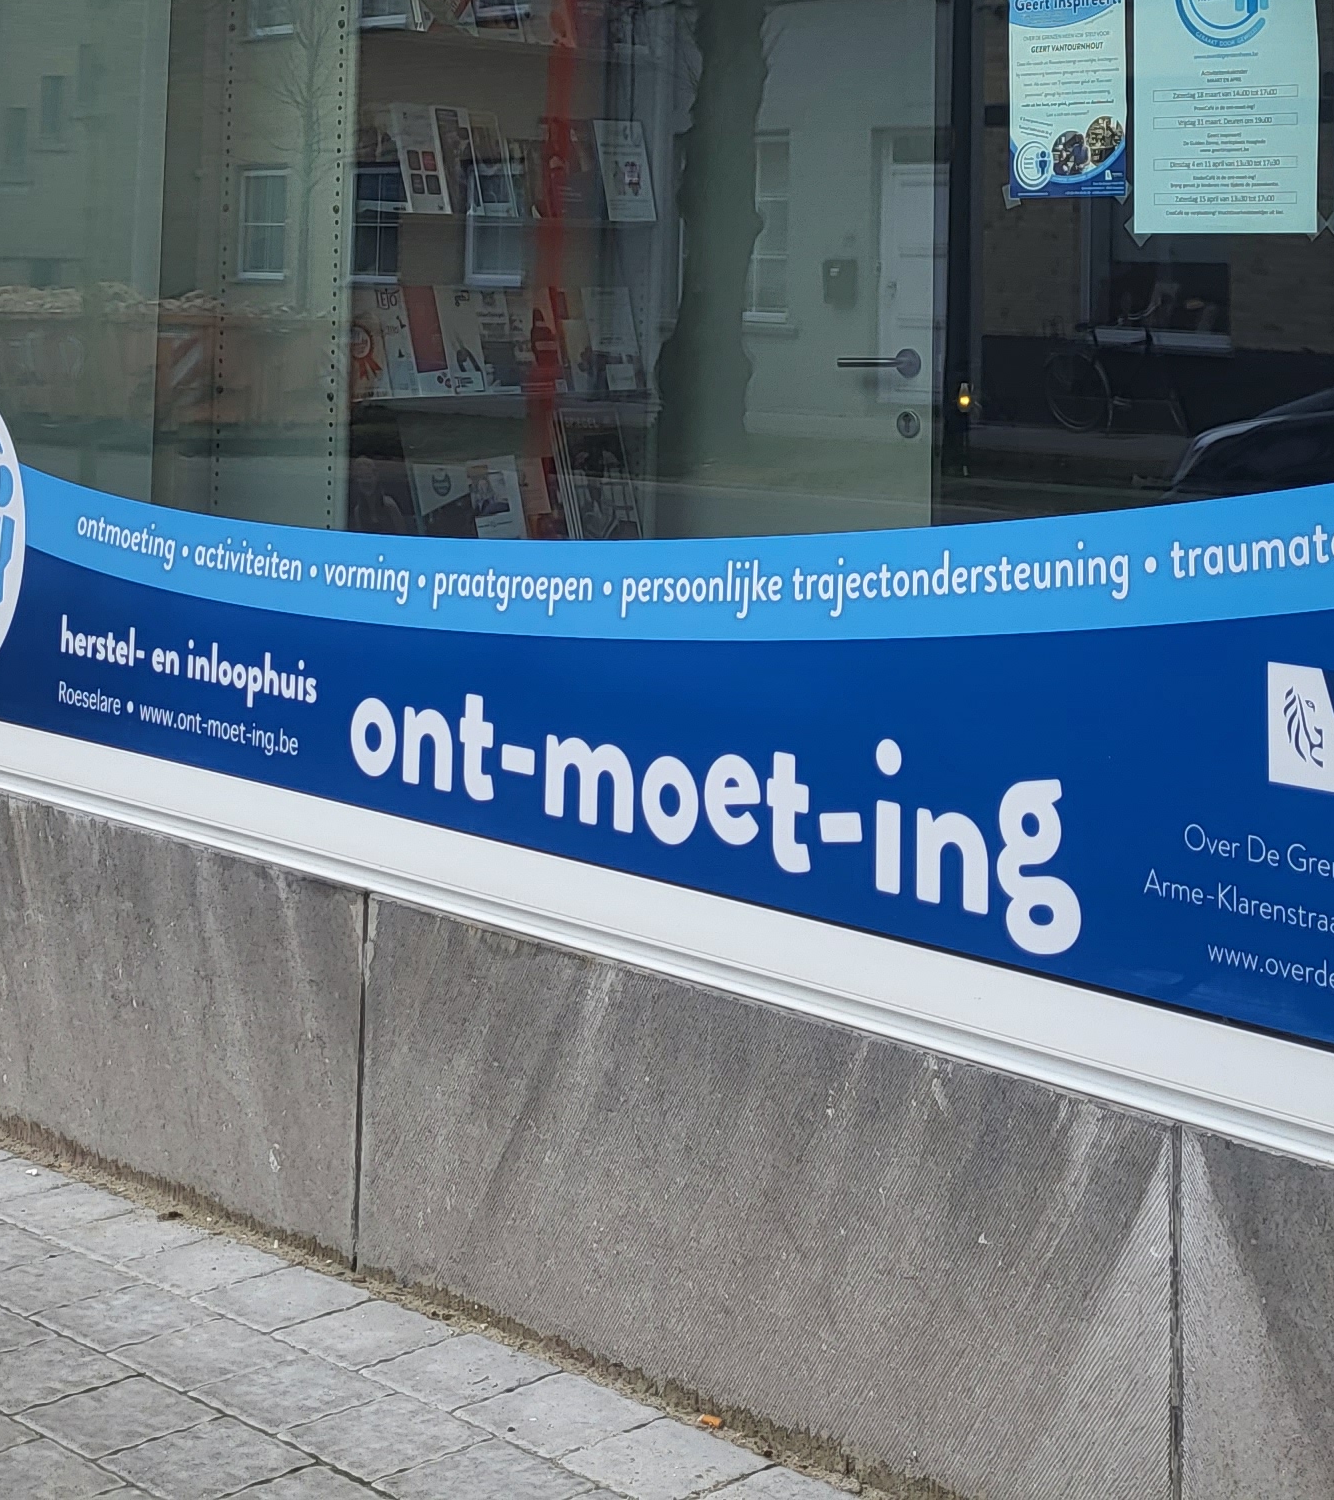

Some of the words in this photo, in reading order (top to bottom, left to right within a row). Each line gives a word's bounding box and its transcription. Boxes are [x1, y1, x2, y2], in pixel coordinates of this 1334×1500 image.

[77, 514, 175, 571] ontmoeting
[194, 538, 302, 581] activiteiten
[324, 556, 410, 605] vorming
[433, 560, 593, 616] praatgroepen
[621, 557, 783, 619] persoonlijke
[792, 541, 1130, 618] trajectondersteuning
[61, 614, 145, 667] herstel-
[152, 648, 180, 676] en
[188, 639, 317, 707] inloophuis
[59, 681, 121, 715] Roeselare
[140, 704, 299, 755] www.ont-moet-ing.be
[351, 694, 1081, 954] ont-moet-ing
[1185, 823, 1240, 859] Over
[1248, 835, 1280, 866] De
